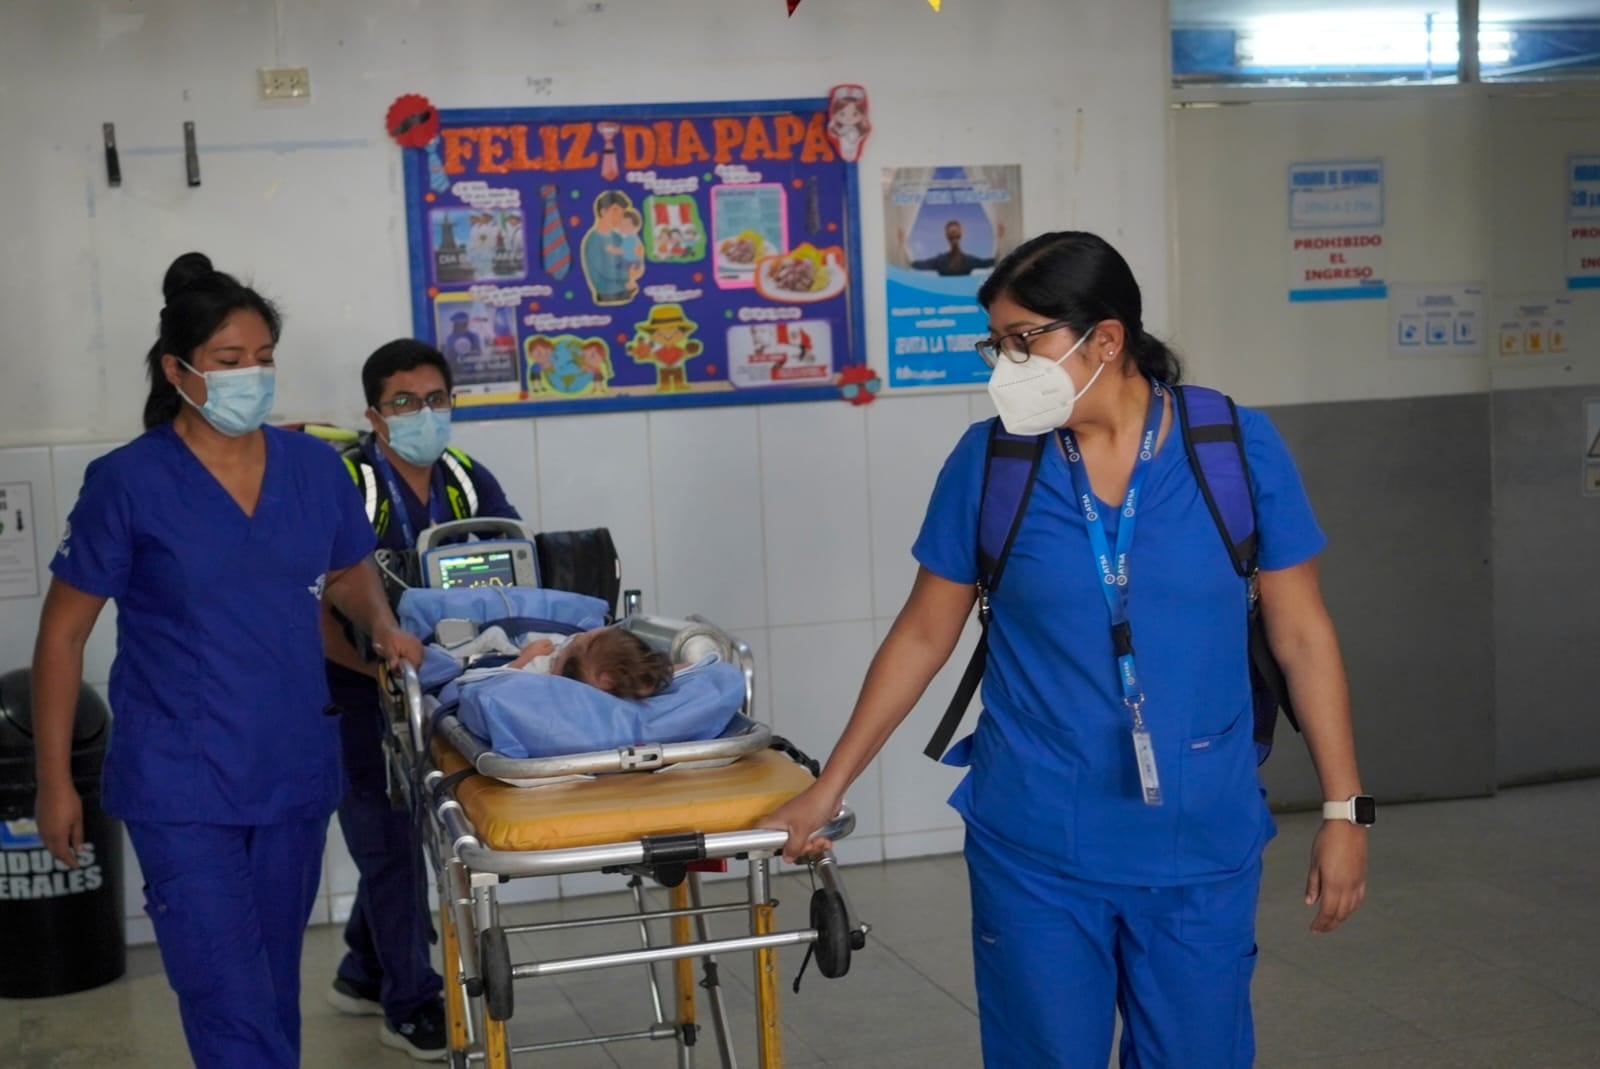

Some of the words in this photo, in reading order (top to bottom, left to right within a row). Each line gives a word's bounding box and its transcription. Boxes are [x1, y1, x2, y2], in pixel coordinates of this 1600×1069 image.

[442, 122, 598, 175] FELIZ
[623, 119, 710, 169] DIA
[1293, 235, 1383, 250] PROHIBIDO
[1329, 252, 1346, 264] EL
[1304, 266, 1373, 281] INGRESO
[1143, 430, 1154, 450] ATSA
[1081, 493, 1093, 512] ATSA
[1125, 488, 1136, 507] ATSA
[1099, 553, 1110, 574] ATSA
[1117, 553, 1127, 574] ATSA
